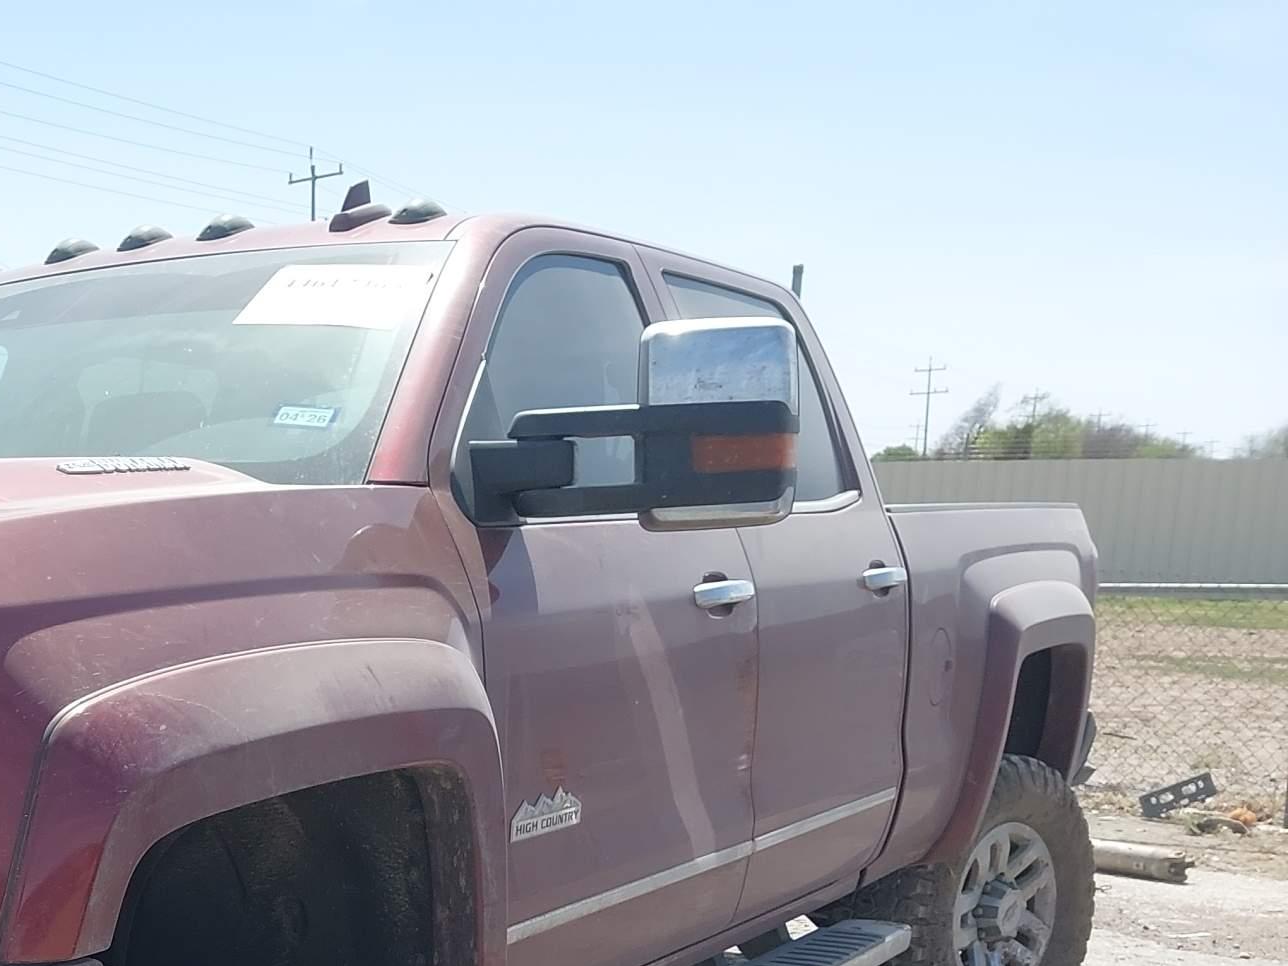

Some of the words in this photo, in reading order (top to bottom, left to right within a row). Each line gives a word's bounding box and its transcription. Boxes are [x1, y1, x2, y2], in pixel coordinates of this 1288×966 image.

[279, 412, 300, 421] 04
[306, 413, 328, 424] 26
[515, 821, 539, 837] HIGH
[541, 810, 580, 830] COUNTRY
